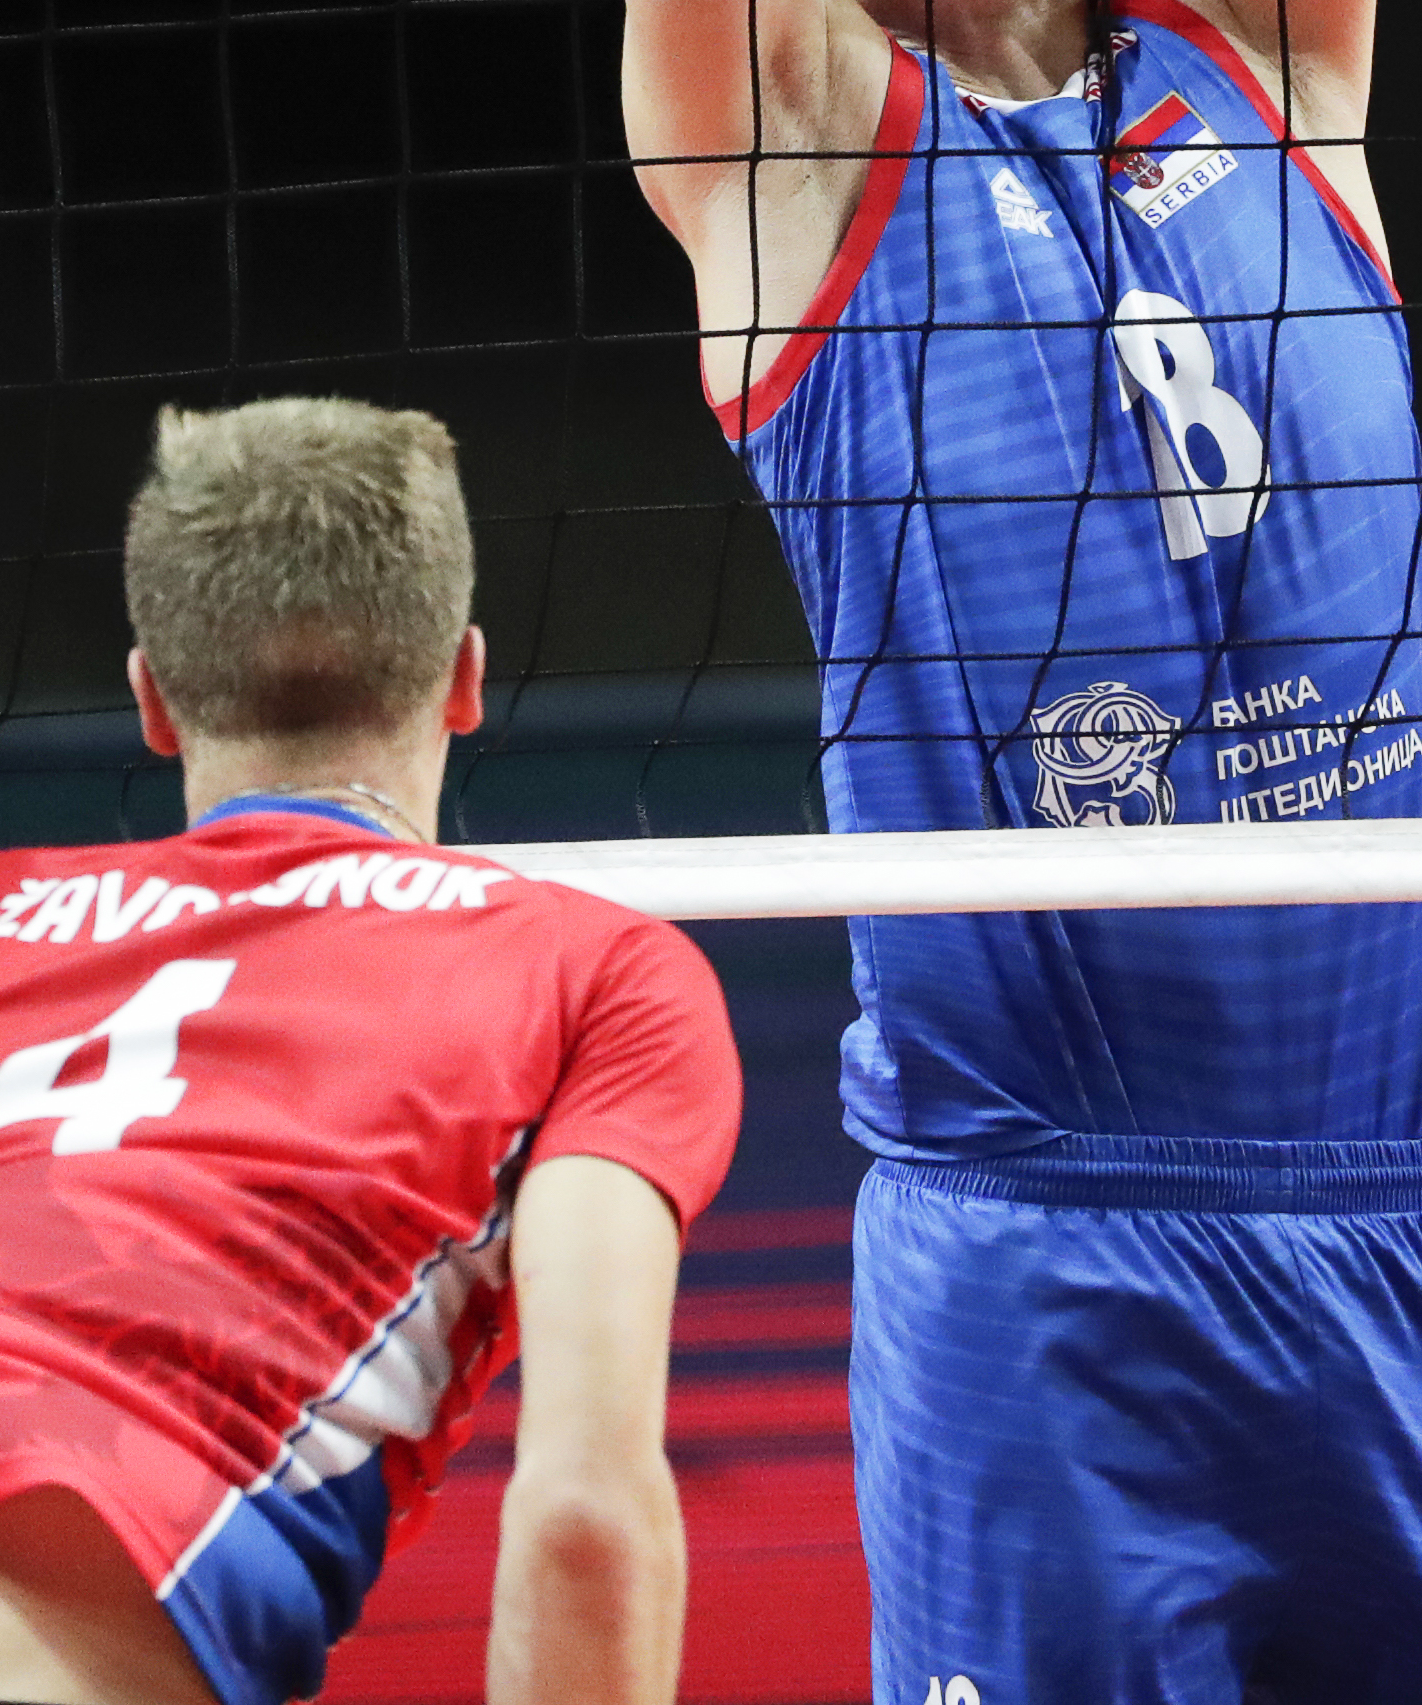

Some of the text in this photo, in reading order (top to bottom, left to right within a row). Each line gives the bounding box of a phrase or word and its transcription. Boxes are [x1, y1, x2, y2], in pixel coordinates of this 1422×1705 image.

[995, 199, 1055, 239] EAK
[1145, 154, 1235, 224] SERBIA
[1115, 288, 1272, 561] 18
[1211, 674, 1323, 728] БАНКА
